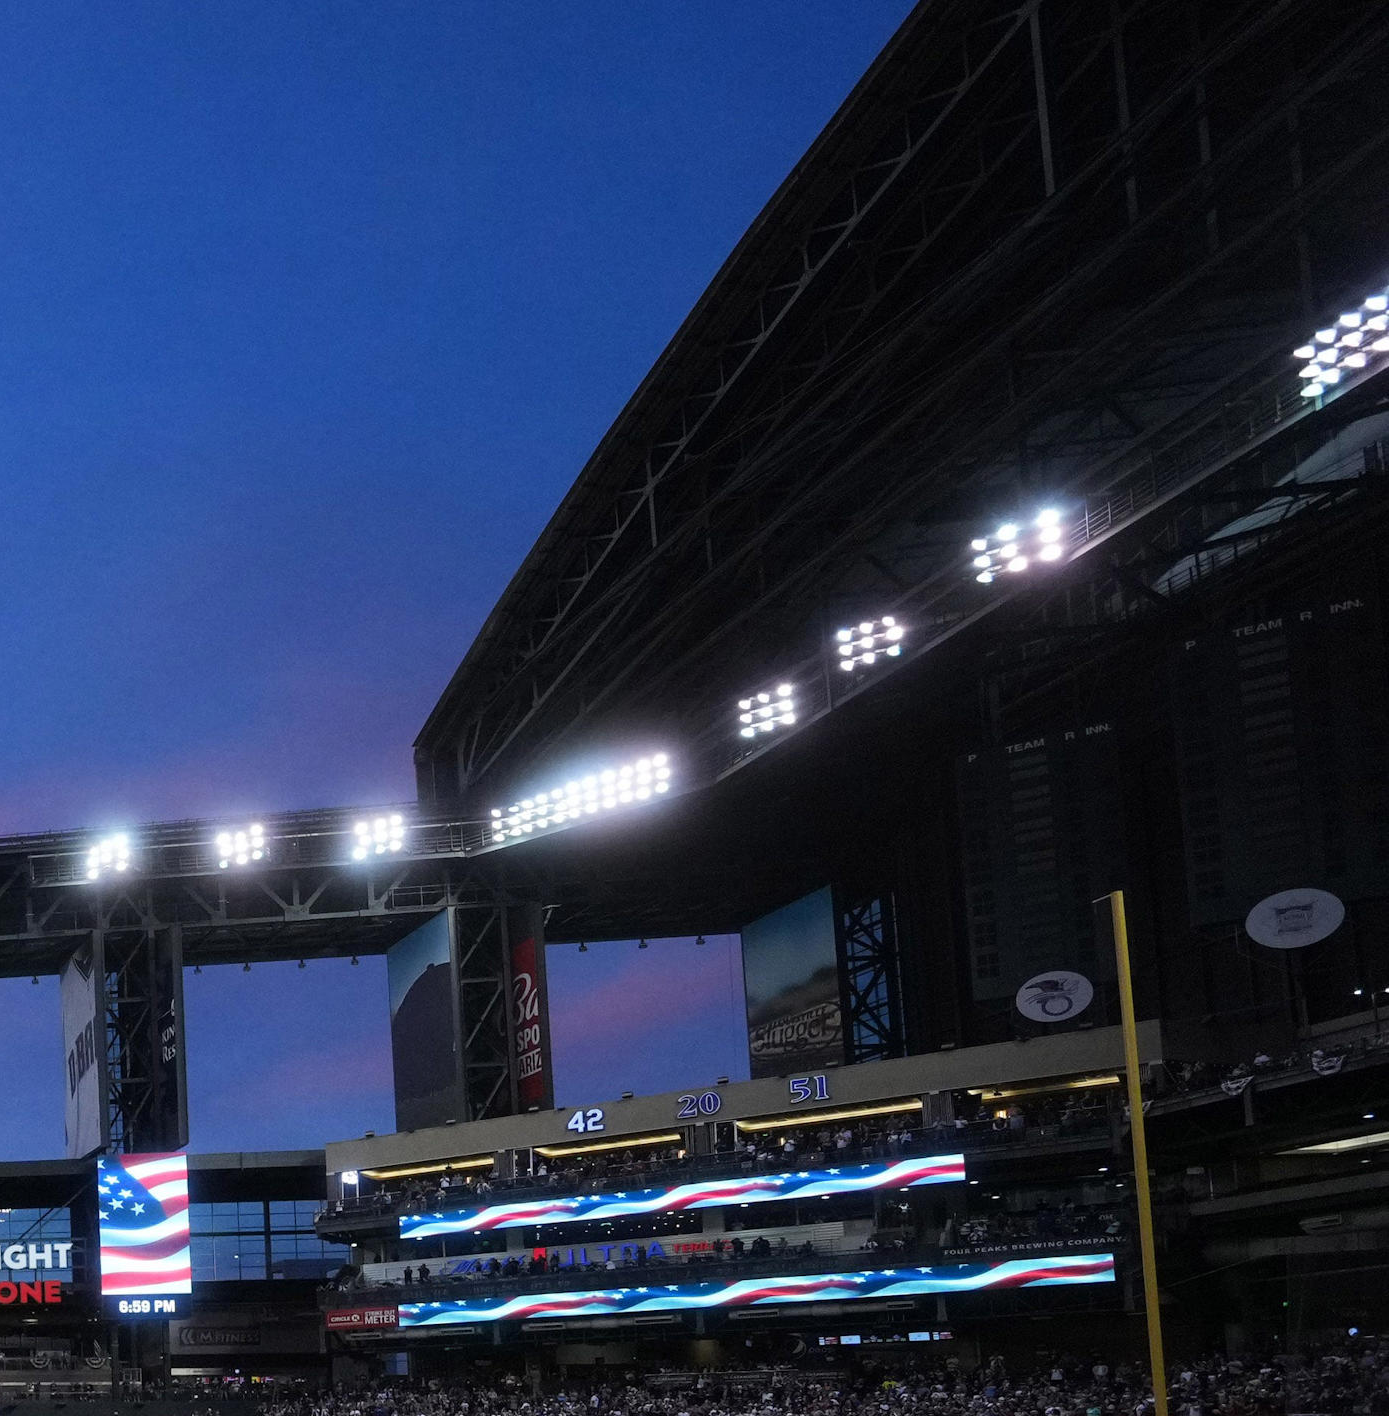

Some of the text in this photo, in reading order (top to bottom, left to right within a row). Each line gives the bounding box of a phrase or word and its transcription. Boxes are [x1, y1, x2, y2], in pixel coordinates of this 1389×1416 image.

[1233, 618, 1283, 638] TEAM
[1006, 738, 1045, 754] TEAM
[789, 1075, 829, 1104] 51
[677, 1091, 721, 1119] 20
[568, 1109, 604, 1133] 42
[944, 1248, 971, 1256] FOUR
[974, 1245, 1008, 1254] PEAKS
[1011, 1240, 1065, 1251] BREWING
[119, 1300, 176, 1314] 6:59 PM
[365, 1315, 396, 1325] METER
